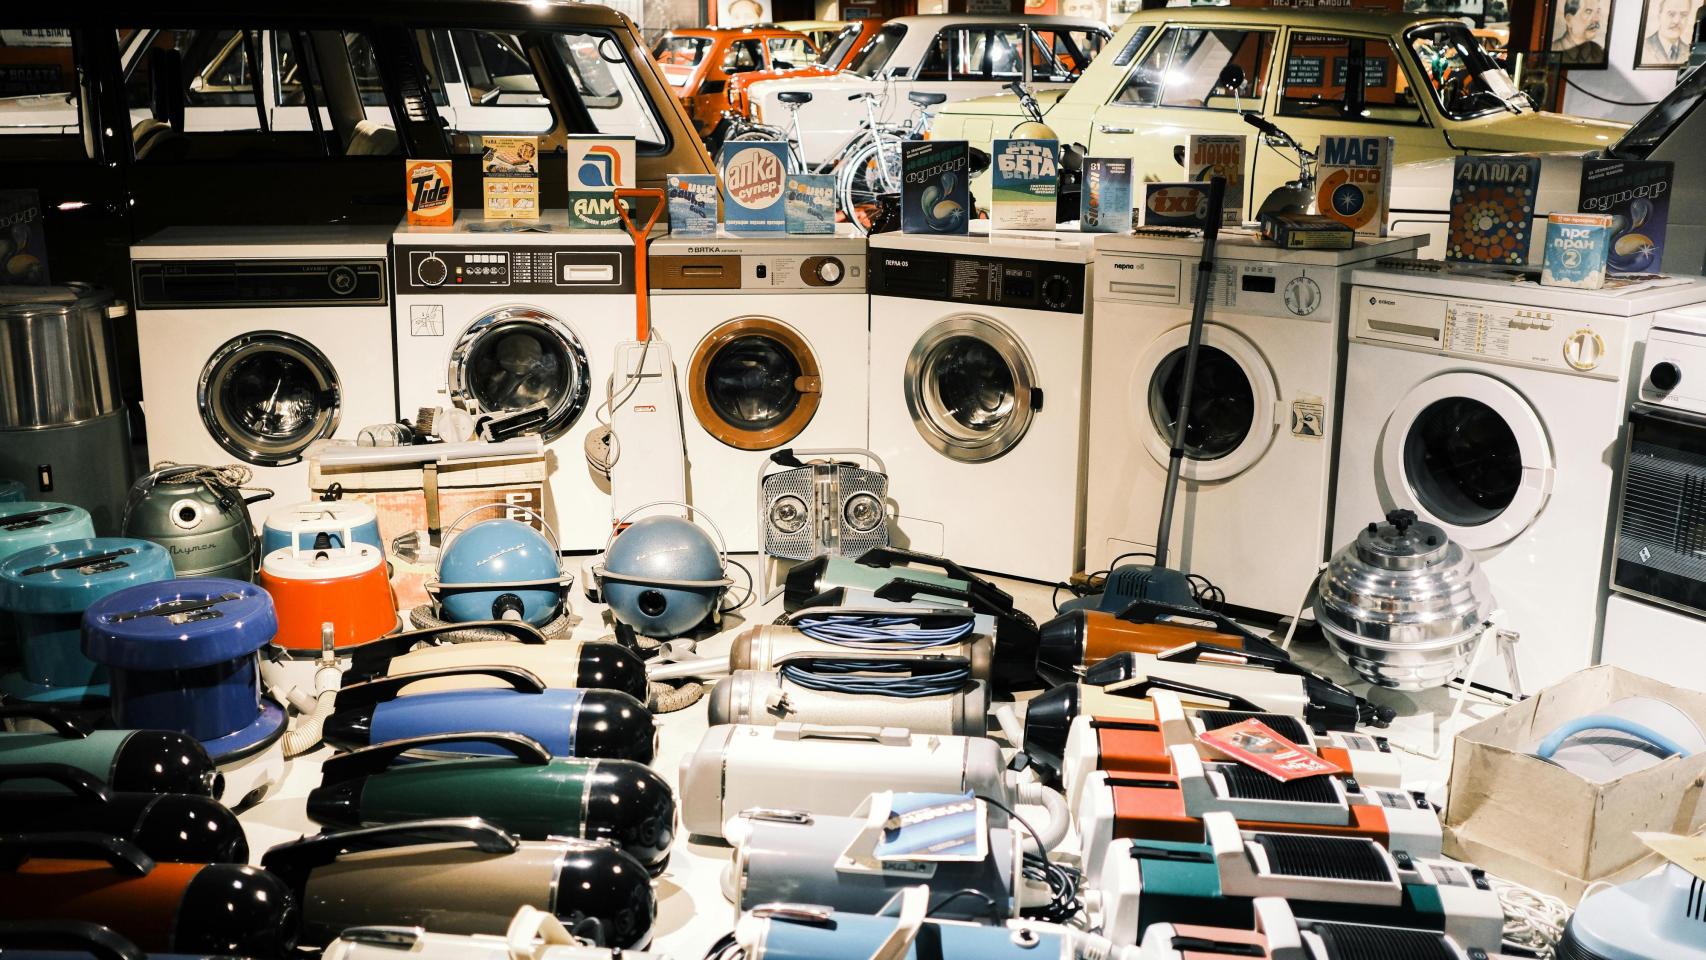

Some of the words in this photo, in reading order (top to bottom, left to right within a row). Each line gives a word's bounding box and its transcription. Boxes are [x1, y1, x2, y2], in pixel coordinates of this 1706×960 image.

[1324, 137, 1379, 166] MAG
[728, 151, 778, 190] алка
[997, 153, 1056, 176] БЕТА
[1090, 162, 1101, 171] 81
[1457, 162, 1530, 182] АЛМА
[1348, 168, 1380, 184] 100
[411, 174, 449, 211] Tide
[738, 181, 777, 199] супер
[1153, 189, 1200, 213] ixi
[1564, 251, 1578, 266] 2
